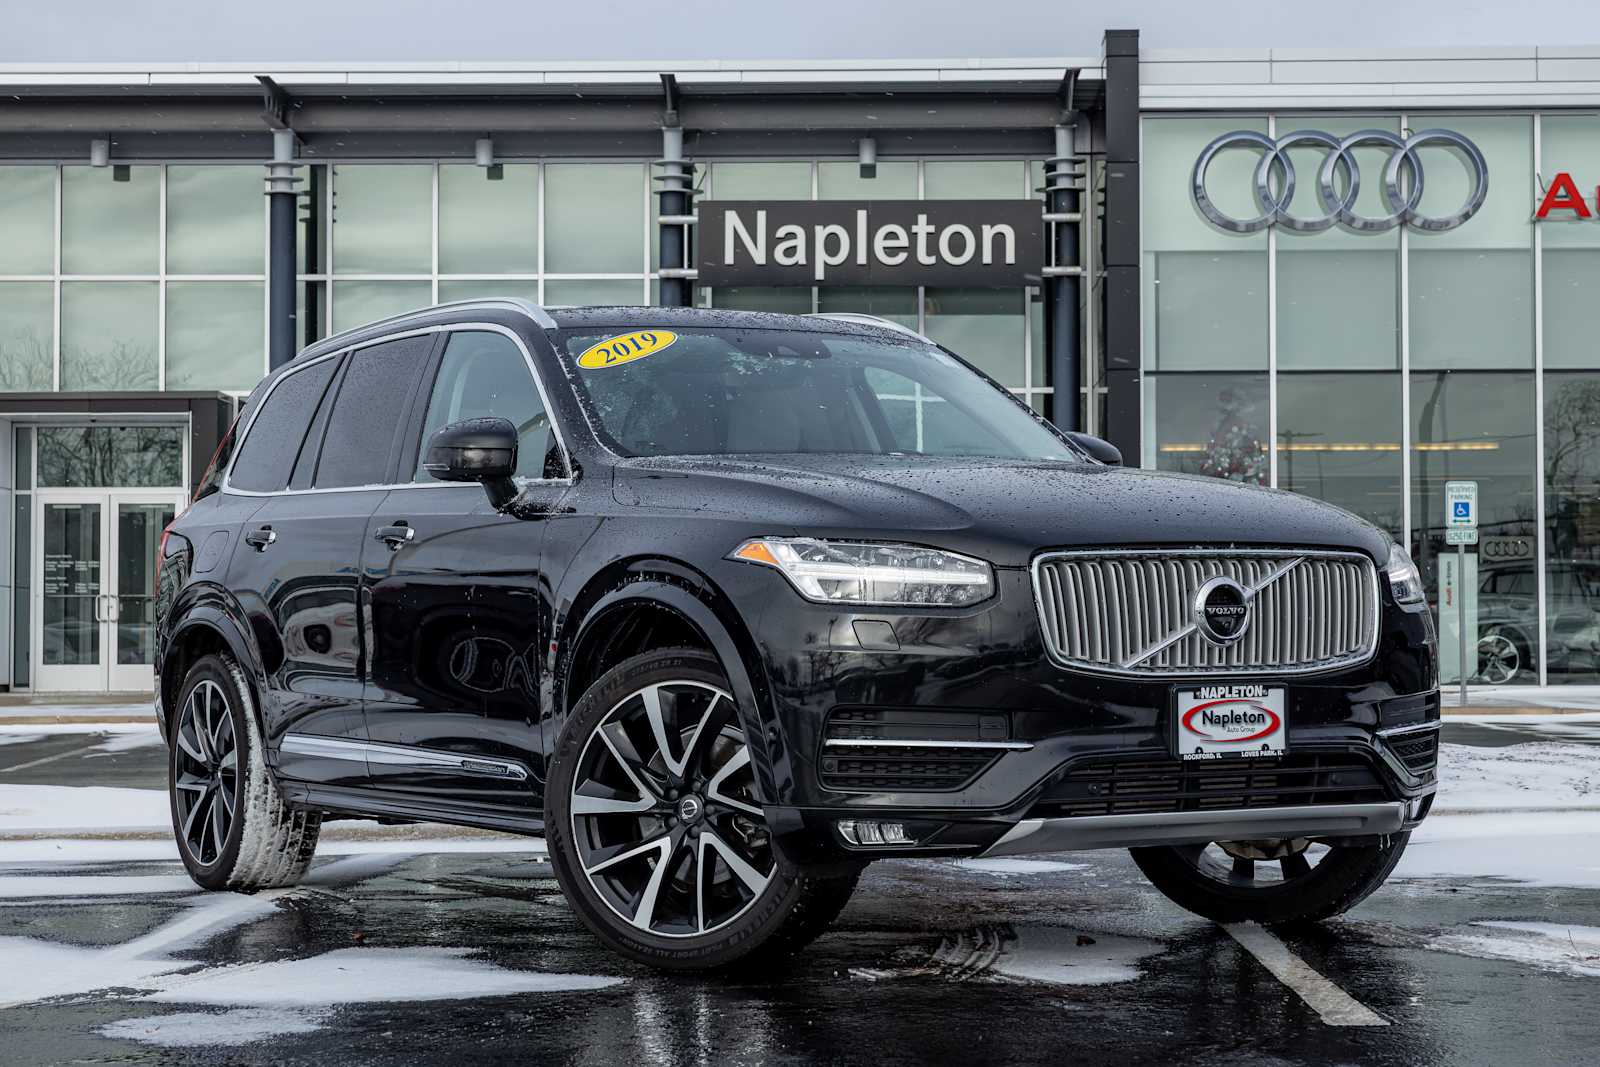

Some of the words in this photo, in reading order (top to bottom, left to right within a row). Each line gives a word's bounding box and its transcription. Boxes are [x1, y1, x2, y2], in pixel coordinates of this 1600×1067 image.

[1536, 173, 1600, 218] A
[724, 210, 1016, 280] Napleton
[597, 333, 657, 363] 2019
[1206, 607, 1244, 615] VOLVO
[1200, 685, 1263, 698] NAPLETON
[1202, 710, 1265, 728] Napleton
[1240, 725, 1256, 734] Group
